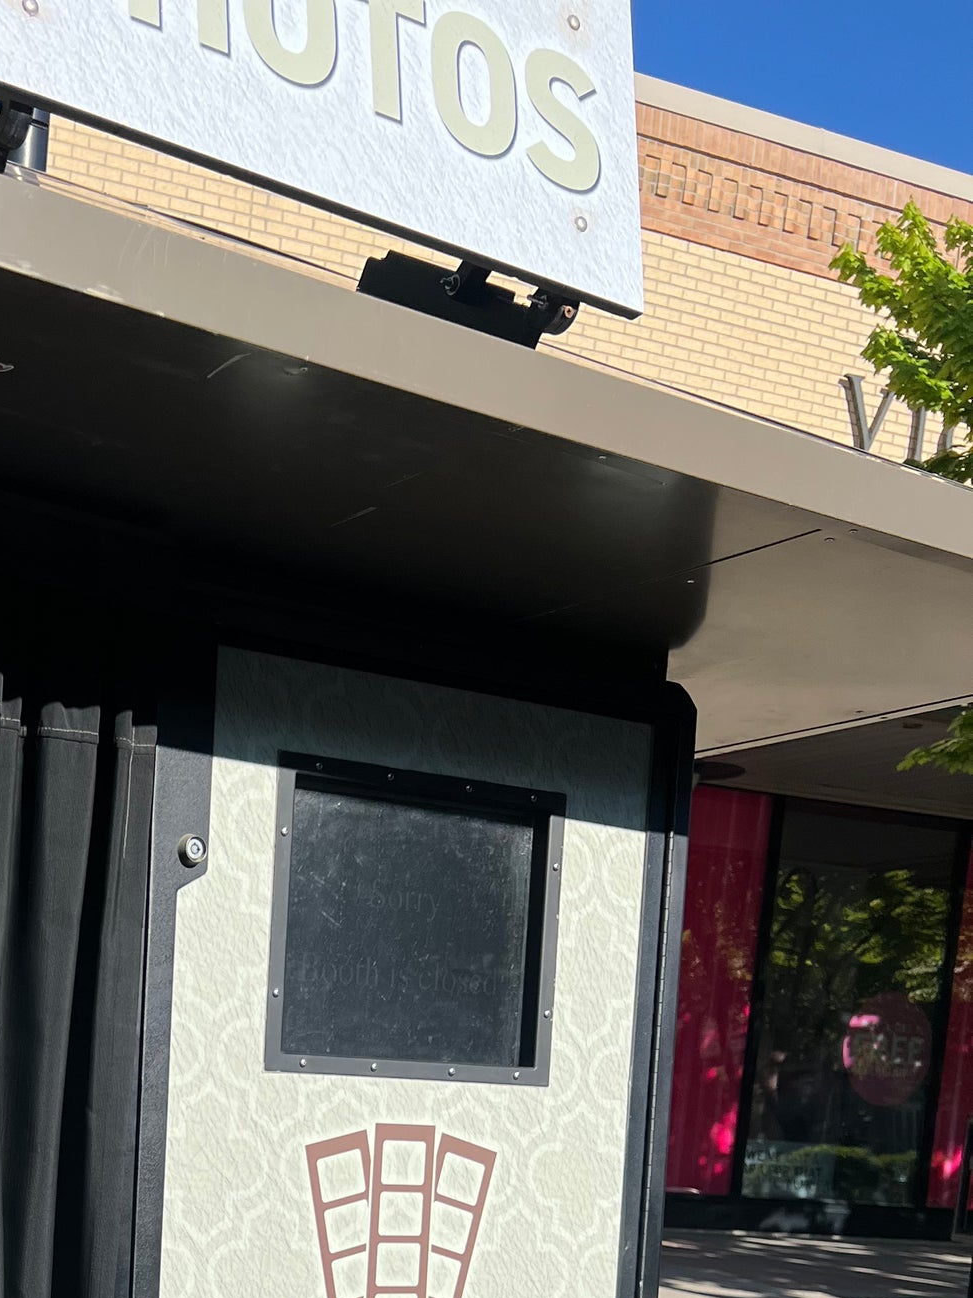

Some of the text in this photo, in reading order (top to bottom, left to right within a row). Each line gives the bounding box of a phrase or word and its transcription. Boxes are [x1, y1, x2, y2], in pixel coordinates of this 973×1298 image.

[131, 0, 599, 191] OTOS
[370, 879, 440, 921] Sorry
[300, 952, 378, 986] Booth
[418, 962, 497, 995] closed
